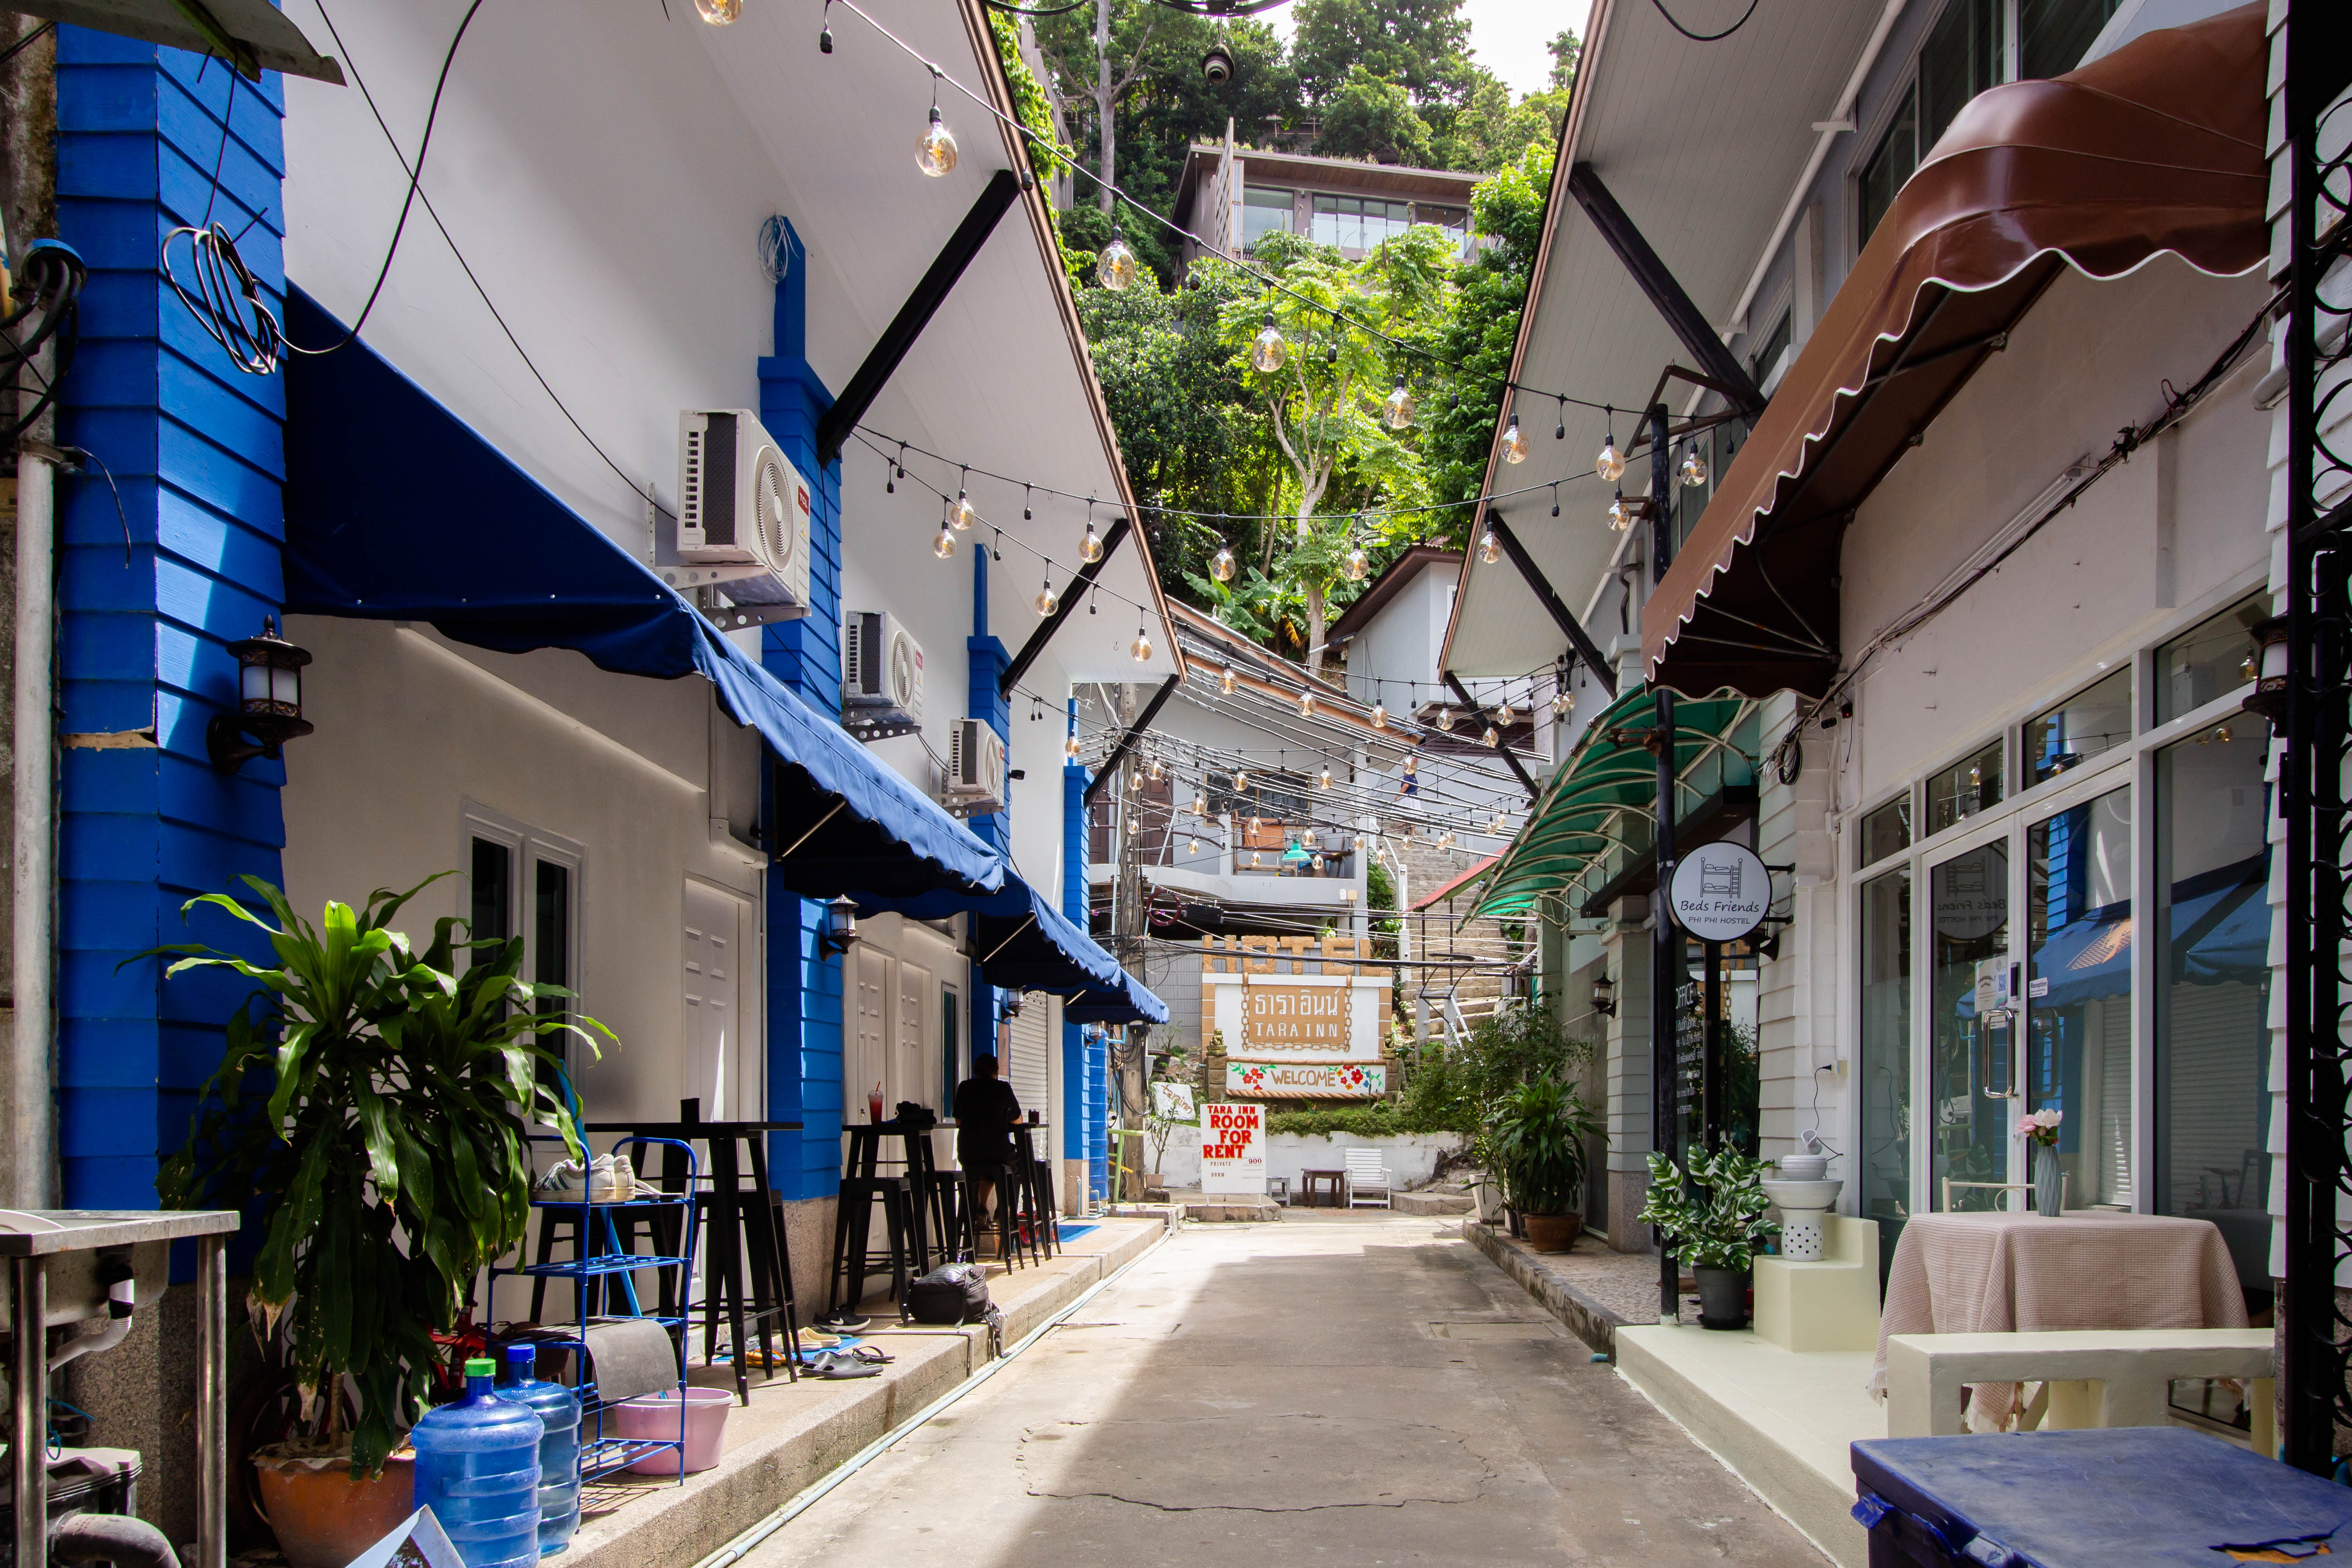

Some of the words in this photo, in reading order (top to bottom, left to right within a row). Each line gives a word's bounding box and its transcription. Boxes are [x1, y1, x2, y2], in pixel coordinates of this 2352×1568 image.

[799, 492, 808, 508] TCL
[1681, 900, 1709, 911] Beds
[1714, 901, 1759, 912] Friends
[1202, 935, 1392, 976] HOTEL
[1255, 1022, 1298, 1037] TARA
[1304, 1023, 1338, 1037] INN
[1271, 1070, 1336, 1087] WELCOME
[1207, 1106, 1233, 1114] TARA
[1238, 1106, 1255, 1115] INN
[1210, 1114, 1259, 1129] ROOM
[1219, 1130, 1253, 1145] FOR
[1202, 1144, 1245, 1159] RENT
